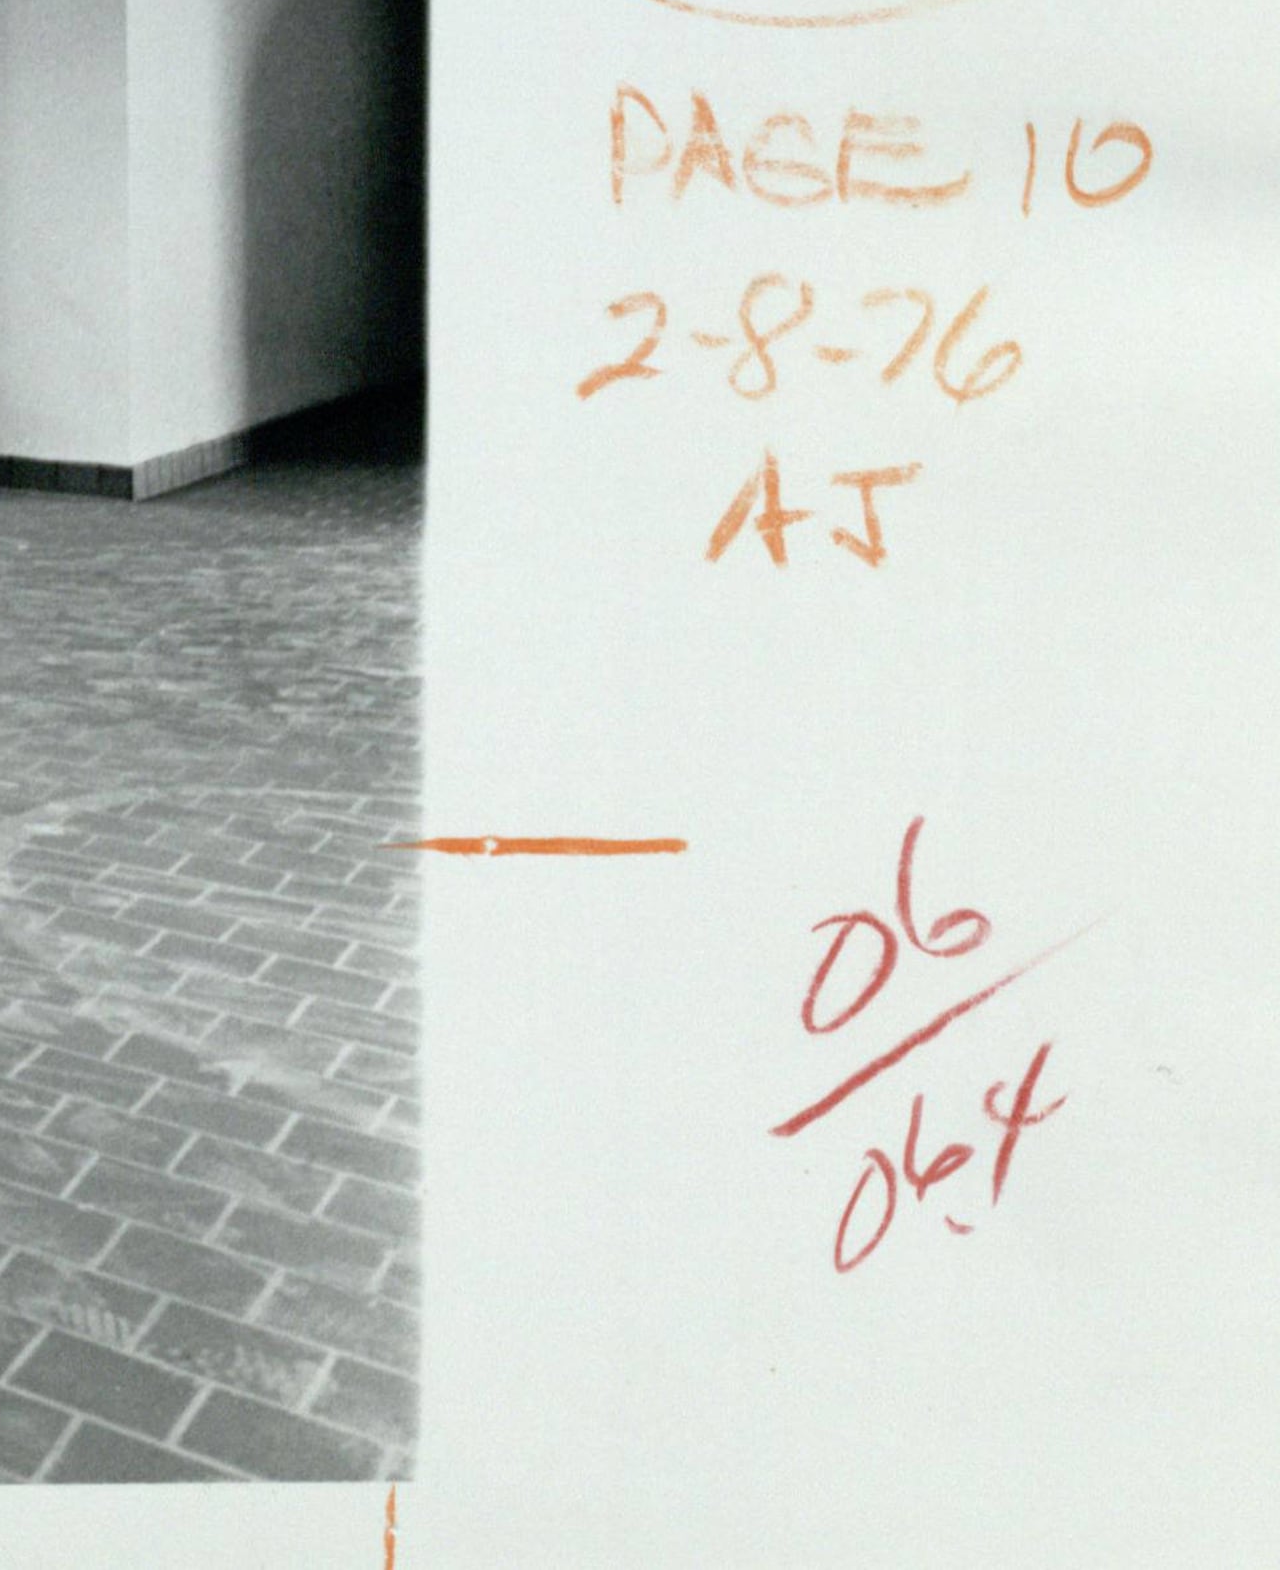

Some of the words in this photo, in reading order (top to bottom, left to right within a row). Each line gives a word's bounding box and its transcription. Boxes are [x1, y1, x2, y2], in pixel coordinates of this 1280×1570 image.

[608, 83, 974, 209] PAGE
[1020, 116, 1156, 220] 10
[574, 270, 1025, 409] 2-8-76
[703, 448, 924, 571] AJ
